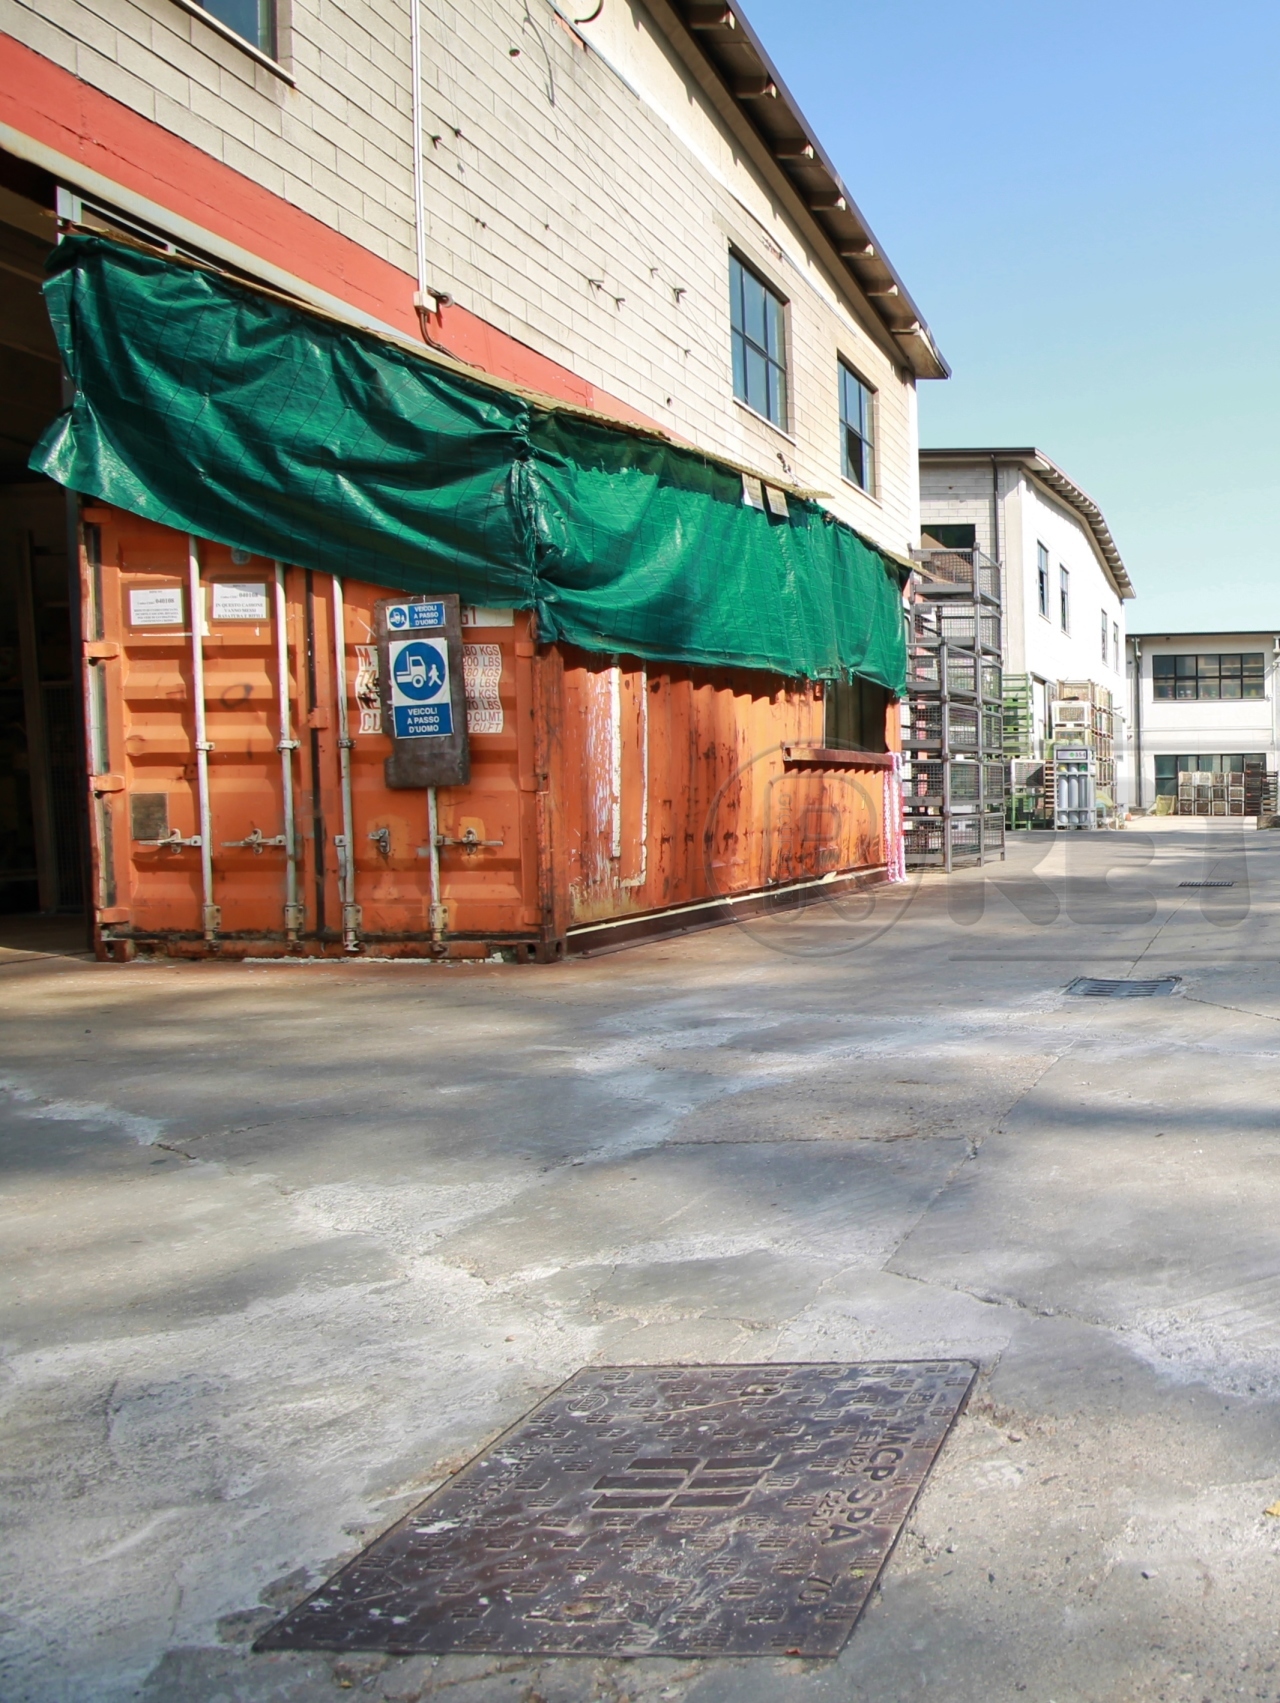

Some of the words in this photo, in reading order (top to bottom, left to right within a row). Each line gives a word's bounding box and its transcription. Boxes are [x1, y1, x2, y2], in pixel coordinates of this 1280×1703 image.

[479, 646, 499, 656] KGS
[483, 657, 501, 667] LBS
[481, 668, 501, 678] KGS
[480, 678, 498, 688] LBS
[479, 689, 498, 700] KGS
[481, 700, 501, 711] LBS
[407, 707, 438, 716] VEICOLI
[414, 716, 440, 724] PASSO
[409, 725, 439, 733] D'UOMO
[862, 1424, 917, 1482] MCP
